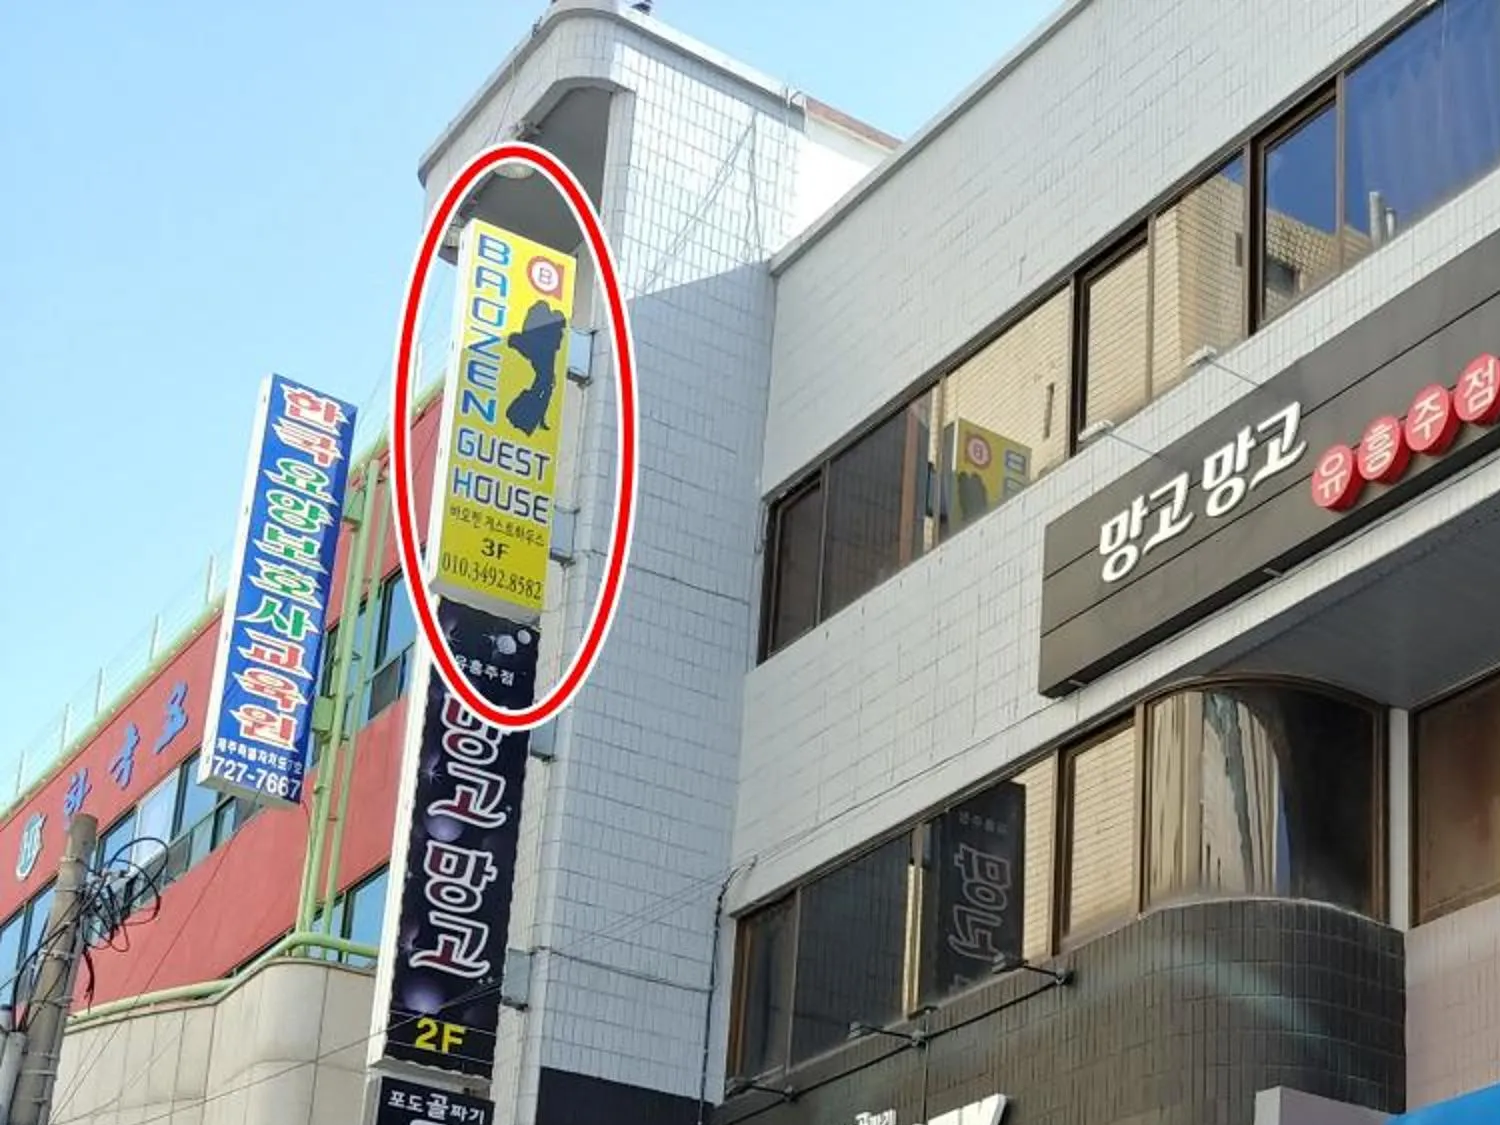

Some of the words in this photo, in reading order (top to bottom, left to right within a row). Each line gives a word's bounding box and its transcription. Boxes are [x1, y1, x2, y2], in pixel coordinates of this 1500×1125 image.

[457, 427, 551, 482] GUEST
[1099, 471, 1197, 584] 망고
[1202, 400, 1309, 518] 망고
[1316, 356, 1496, 501] 유흥주점
[453, 466, 550, 525] HOUSE
[481, 537, 510, 560] 3F
[441, 551, 542, 600] 010.3492.8582
[214, 755, 301, 798] 727-7667
[409, 839, 499, 980] 망고
[415, 1017, 468, 1056] 2F
